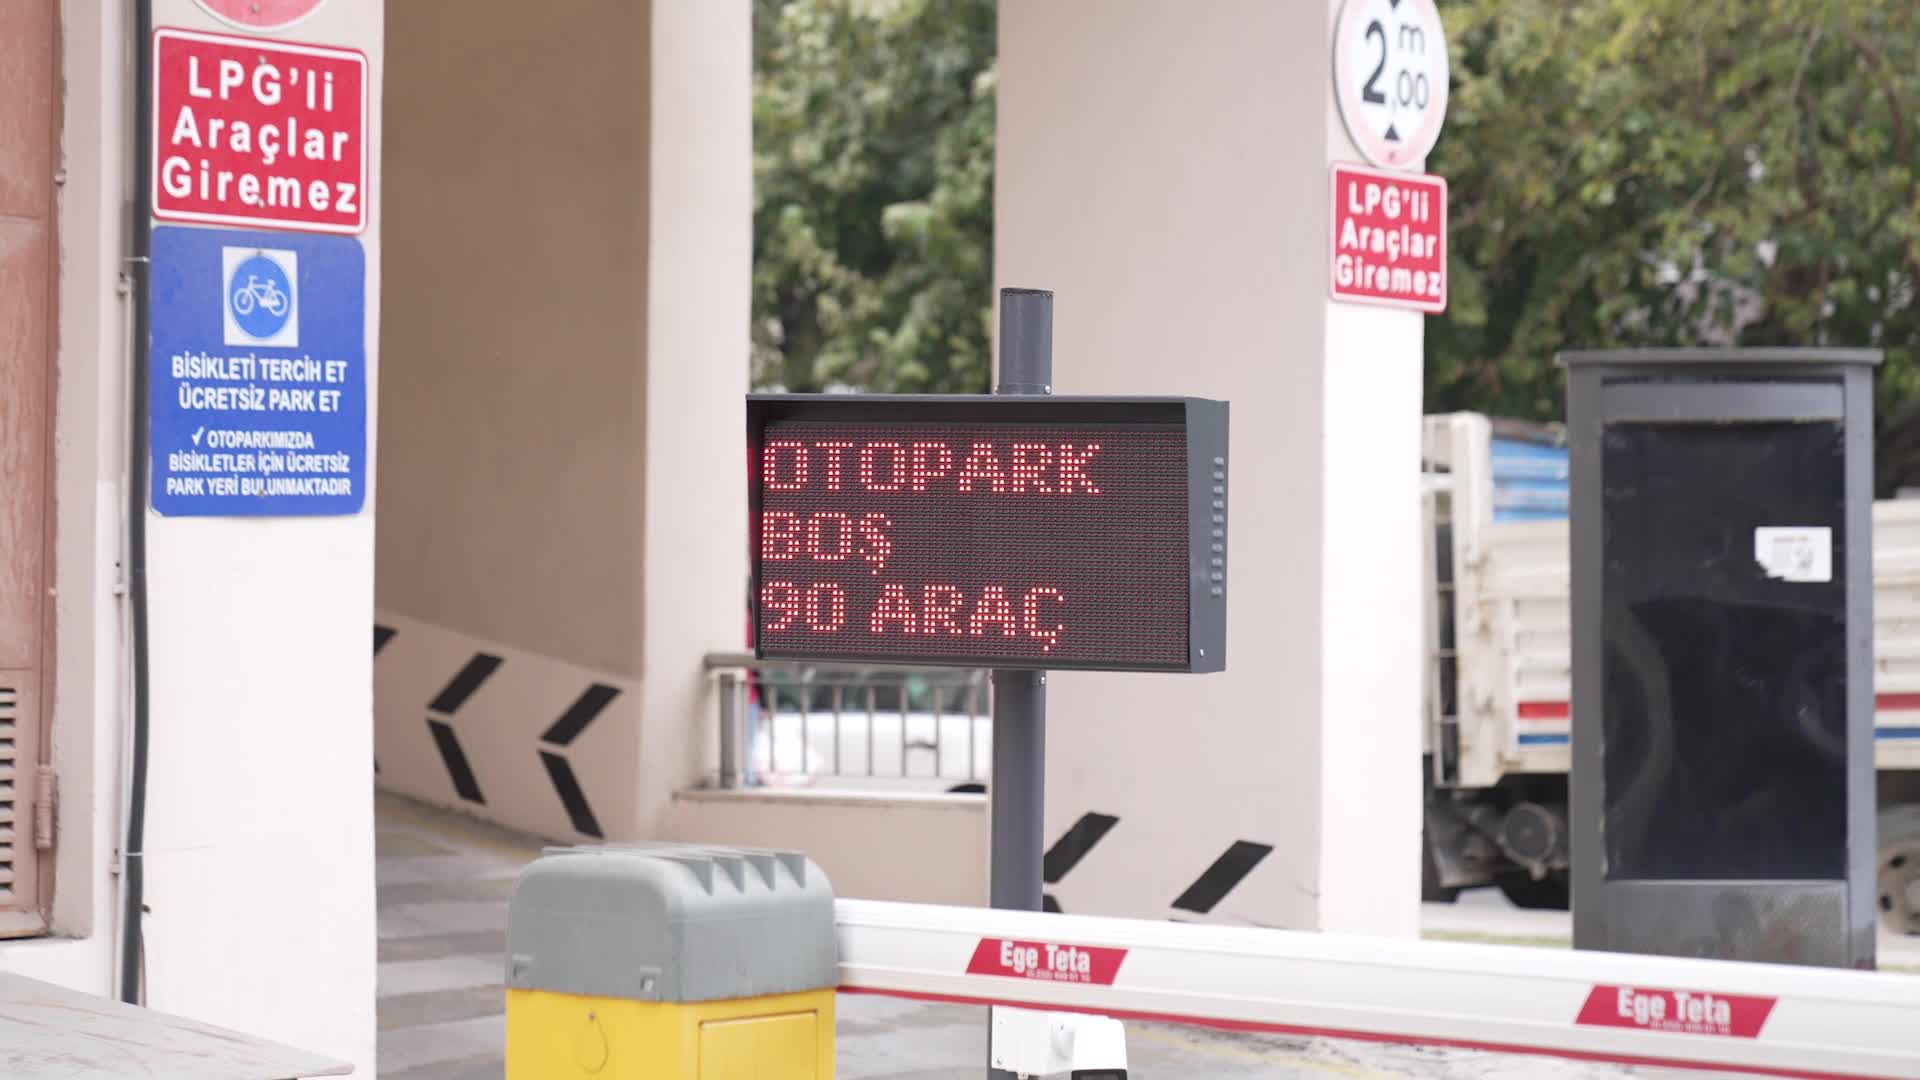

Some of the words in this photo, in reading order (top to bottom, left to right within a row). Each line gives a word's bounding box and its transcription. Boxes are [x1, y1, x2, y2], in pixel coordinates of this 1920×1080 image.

[171, 105, 349, 165] Araçlar
[162, 155, 357, 214] Giremez
[1340, 217, 1437, 261] Araçlar
[1335, 254, 1441, 296] Giremez
[172, 350, 256, 380] BİSİKLETİ
[260, 355, 321, 382] TERCİH
[325, 360, 347, 383] ET
[179, 382, 265, 411] ÜCRETSİZ
[269, 389, 315, 411] PARK
[319, 390, 341, 412] ET
[207, 430, 315, 450] OTOPARKIMIZDA
[169, 451, 256, 473] BİSİKLETLER
[258, 451, 284, 477] İÇİN
[286, 451, 350, 474] ÜCRETSİZ
[763, 441, 1101, 494] OTOPARK
[166, 477, 203, 496] PARK
[206, 475, 239, 496] YERİ
[241, 477, 351, 496] BULUNMAKTADIR
[761, 511, 892, 575] BOŞ
[761, 581, 844, 631] 90
[870, 583, 1064, 651] ARAÇ
[1000, 940, 1038, 973] Ege
[1045, 944, 1091, 973] Teta
[1617, 986, 1666, 1025] Ege
[1673, 991, 1731, 1025] Teta
